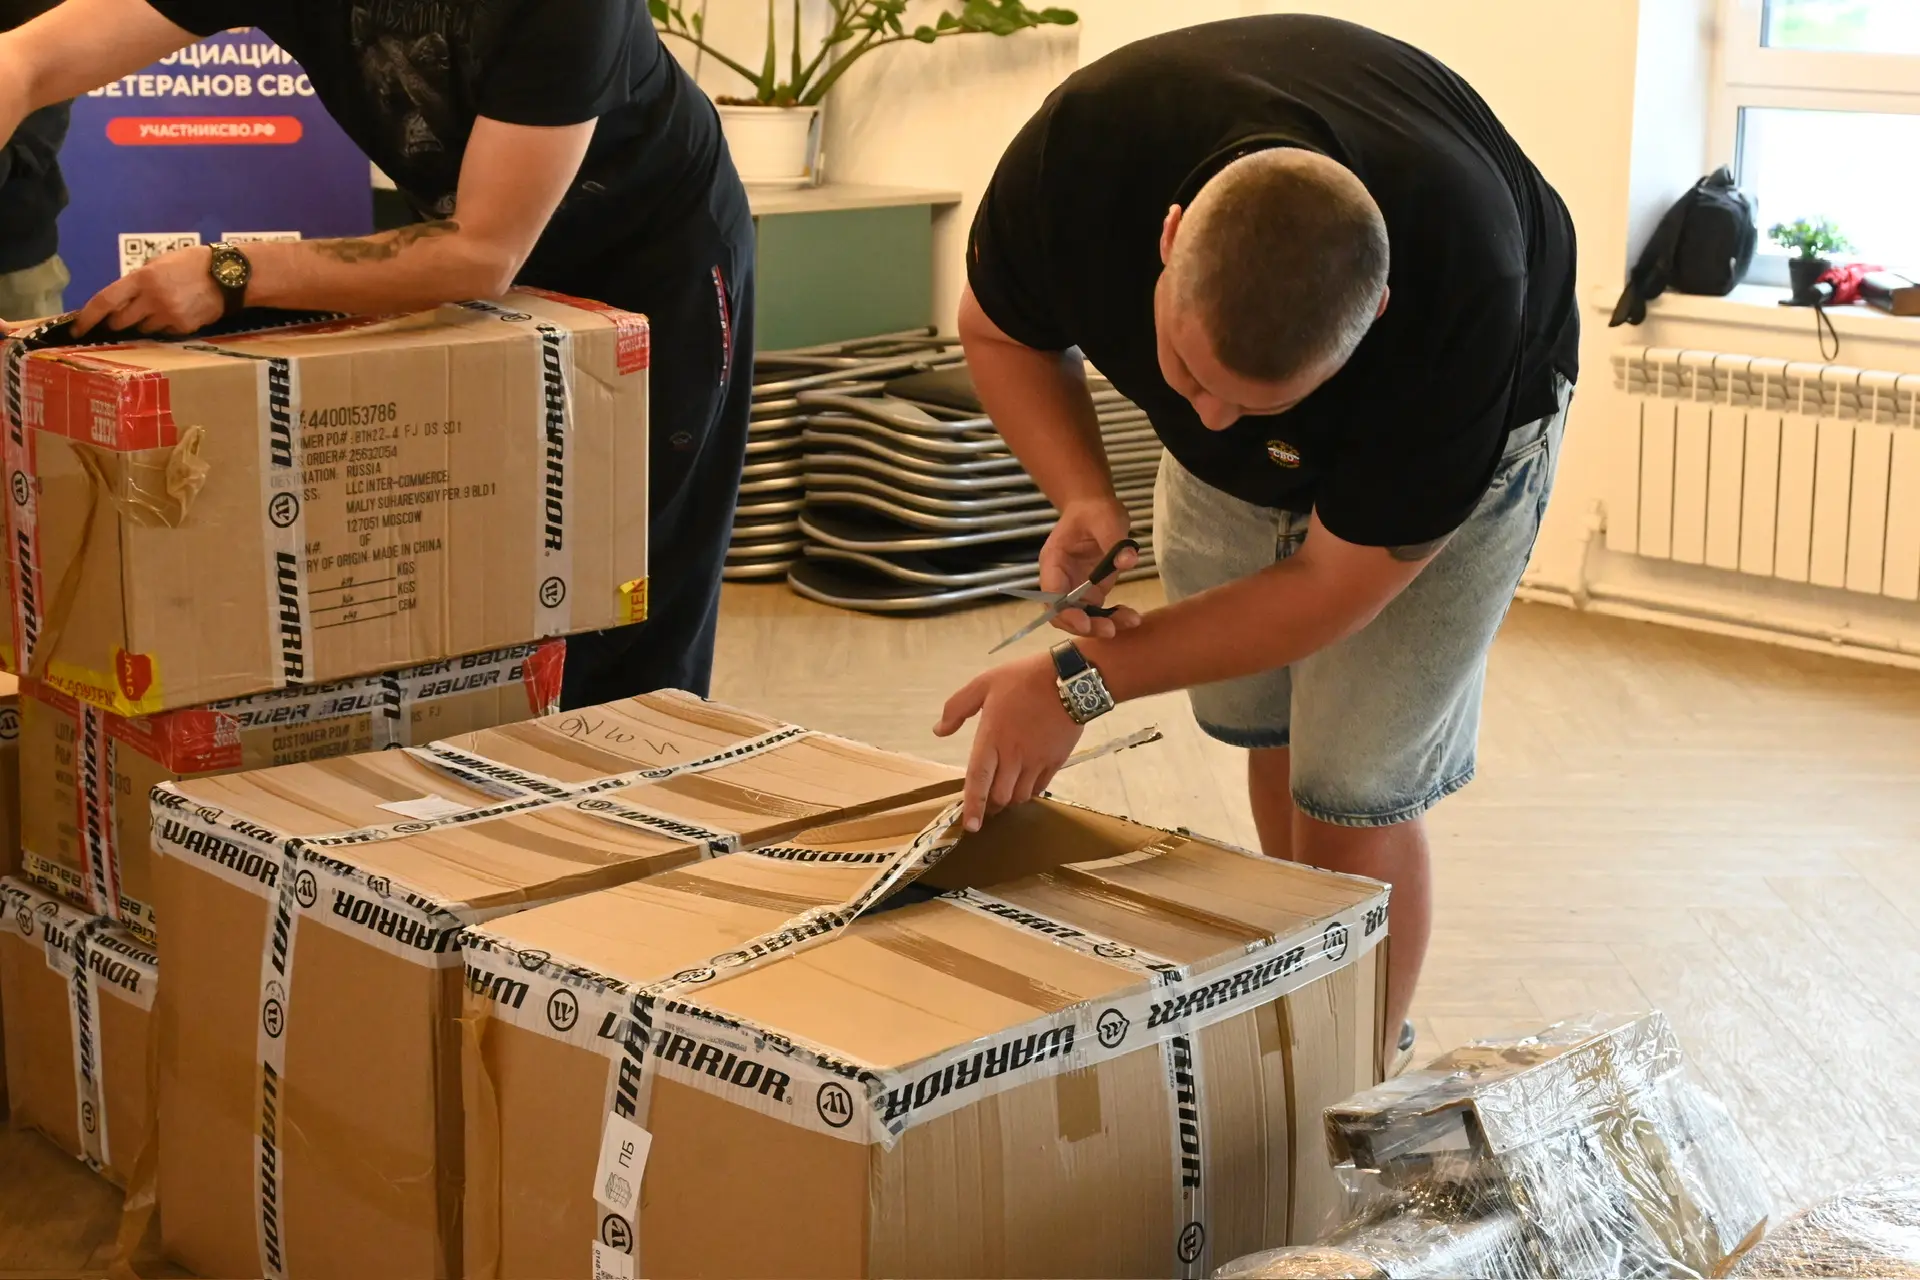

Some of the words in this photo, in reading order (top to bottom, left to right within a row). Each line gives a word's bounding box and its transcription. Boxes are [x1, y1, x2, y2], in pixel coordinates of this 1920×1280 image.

[257, 75, 315, 97] СВО
[139, 123, 276, 138] УЧАСТНИКСВО.РФ
[346, 462, 382, 478] RUSSIA
[346, 481, 364, 496] LLC
[346, 515, 379, 533] 127051
[382, 510, 422, 528] MOSCOW
[359, 533, 371, 547] OF
[322, 556, 334, 570] OF
[373, 544, 399, 561] MADE
[401, 543, 411, 555] IN
[413, 538, 442, 554] CHINA
[397, 561, 415, 576] KGS
[398, 580, 416, 595] KGS
[272, 726, 327, 751] CUSTOMER
[163, 819, 280, 888] WARRIOR
[1147, 945, 1306, 1031] WARRIOR
[886, 1022, 1077, 1123] WARRIOR
[264, 1059, 283, 1275] WARRIOR
